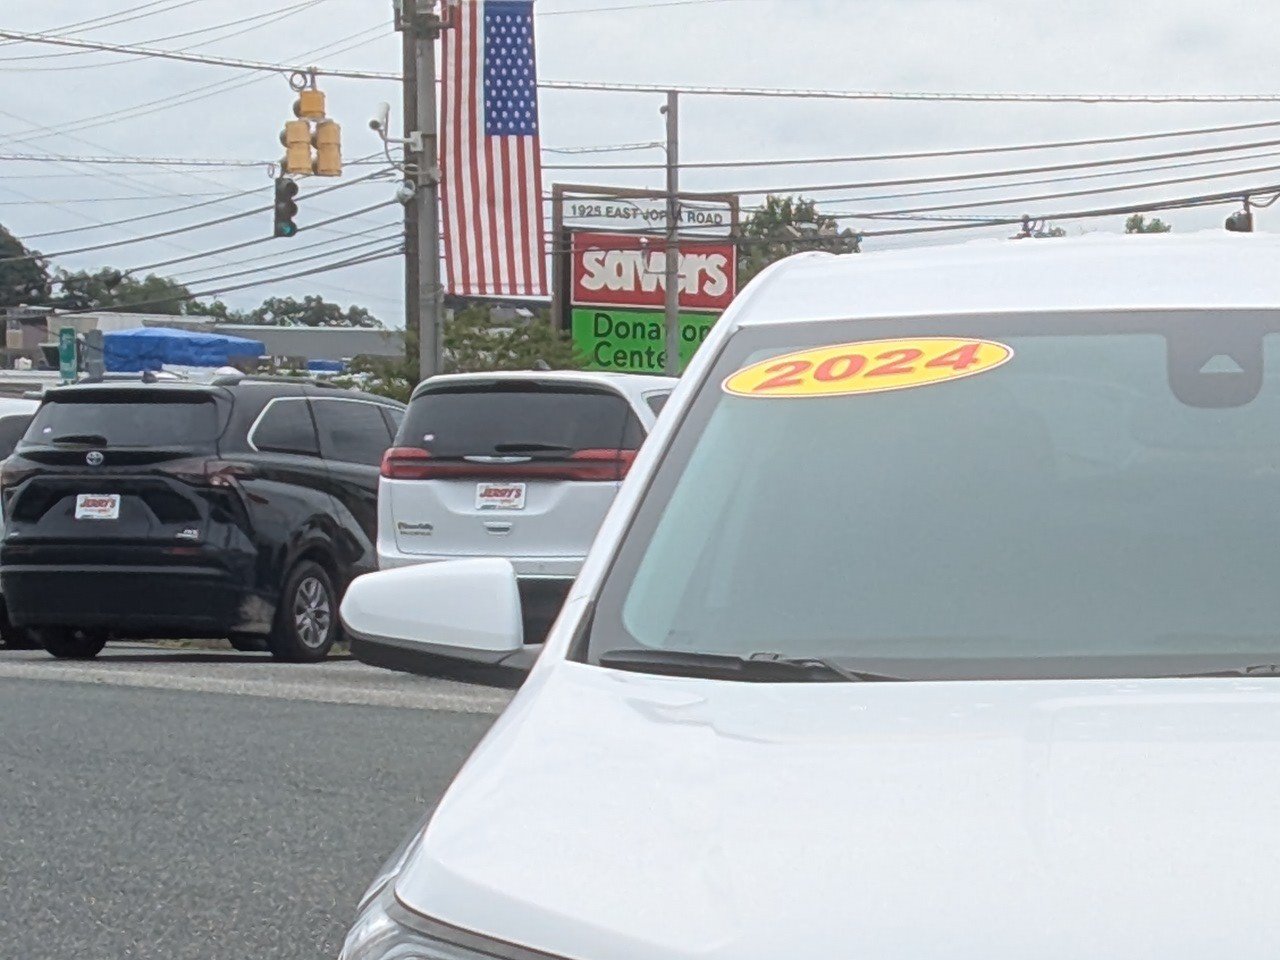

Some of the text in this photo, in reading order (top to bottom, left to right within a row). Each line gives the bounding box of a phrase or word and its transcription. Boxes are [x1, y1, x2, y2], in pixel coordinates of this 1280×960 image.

[571, 204, 601, 217] 1925
[606, 206, 639, 220] EAST
[687, 211, 723, 225] ROAD
[594, 341, 679, 369] Cente
[752, 342, 982, 391] 2024
